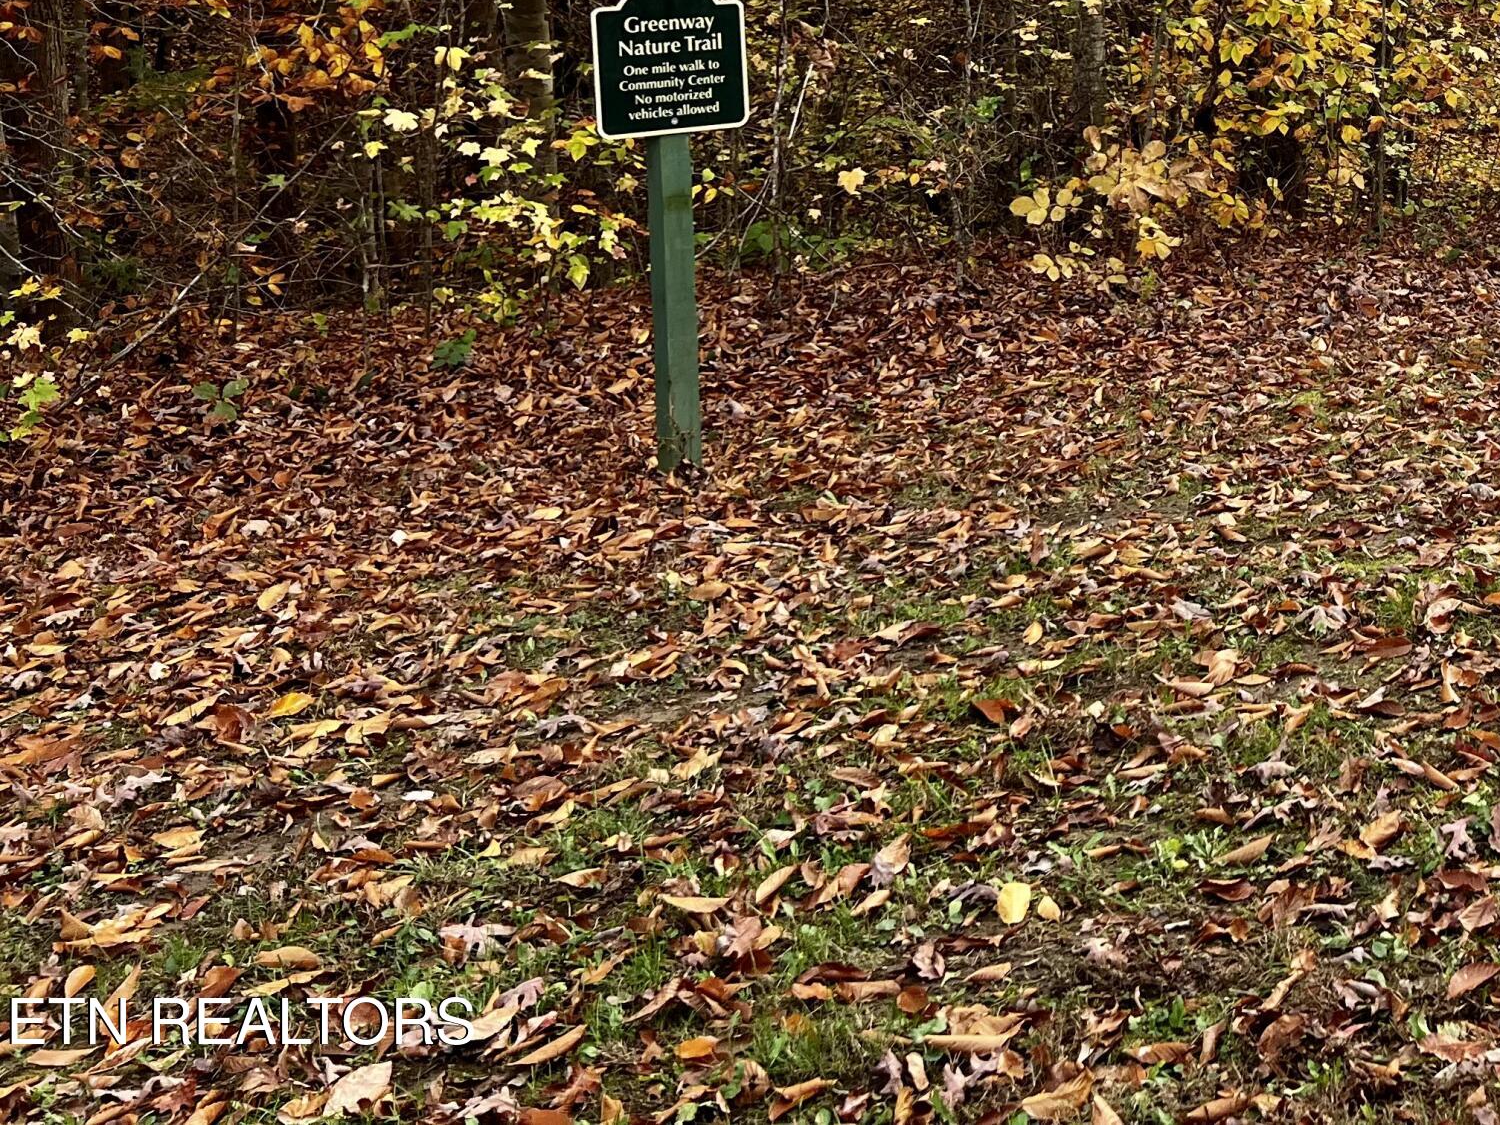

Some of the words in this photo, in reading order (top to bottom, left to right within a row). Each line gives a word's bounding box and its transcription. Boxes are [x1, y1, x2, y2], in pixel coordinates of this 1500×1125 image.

[623, 16, 715, 33] Greenway
[618, 40, 681, 57] Nature
[684, 32, 723, 52] Trail
[623, 65, 649, 76] One
[651, 61, 677, 74] mile
[679, 59, 706, 72] walk
[708, 59, 720, 70] to
[619, 76, 685, 92] Community
[687, 74, 726, 86] Center
[634, 94, 652, 105] No
[655, 87, 713, 103] motorized
[628, 106, 674, 121] vehicles
[676, 101, 720, 116] allowed
